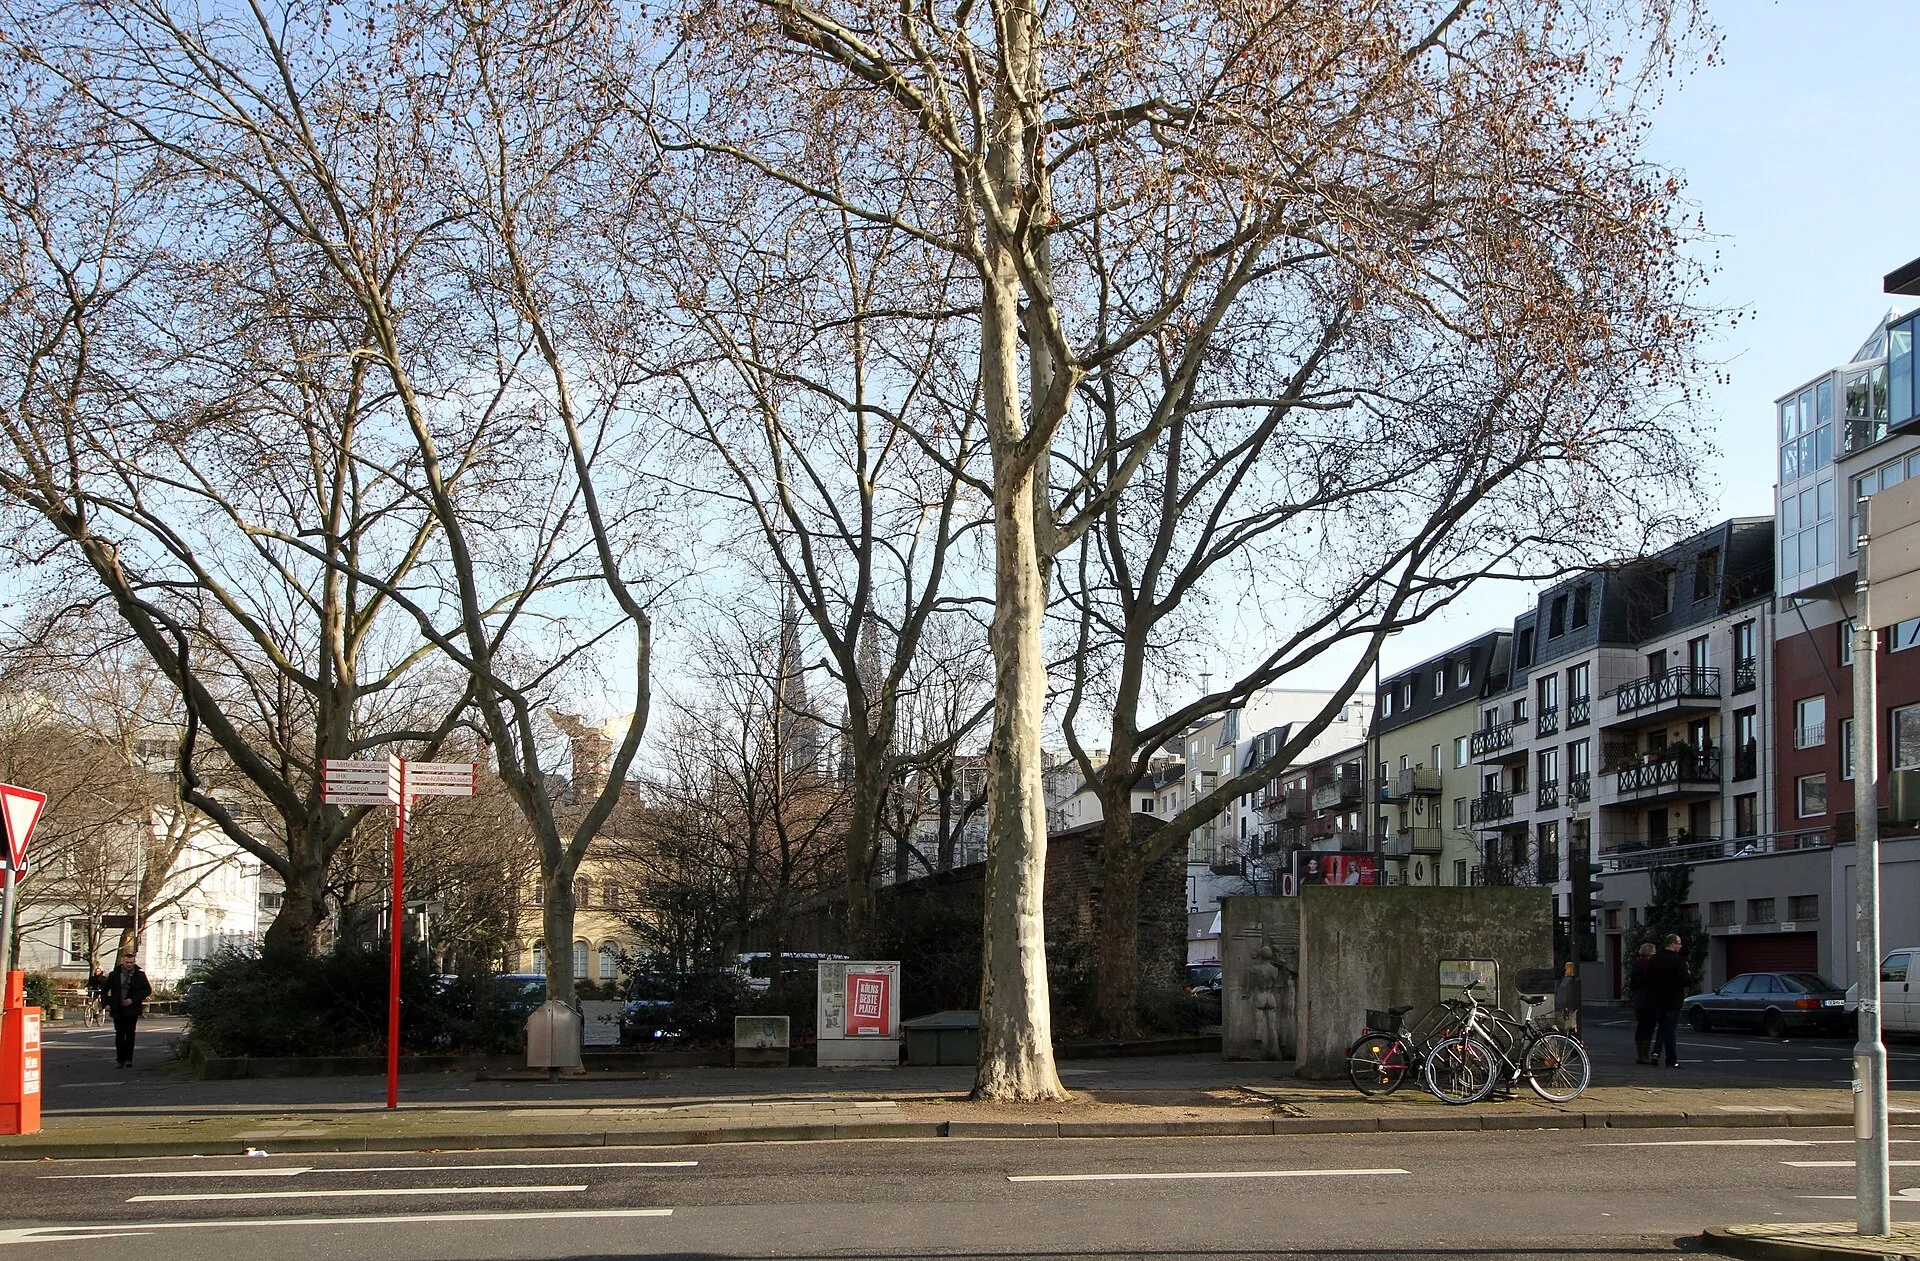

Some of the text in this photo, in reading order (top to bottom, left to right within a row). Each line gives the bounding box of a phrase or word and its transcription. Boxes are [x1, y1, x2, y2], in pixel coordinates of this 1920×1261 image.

[345, 784, 369, 792] Gereon
[415, 786, 444, 794] Shopping
[860, 983, 879, 994] KÖLNS
[859, 994, 878, 1004] BESTE
[858, 1004, 878, 1014] PLÄTZE
